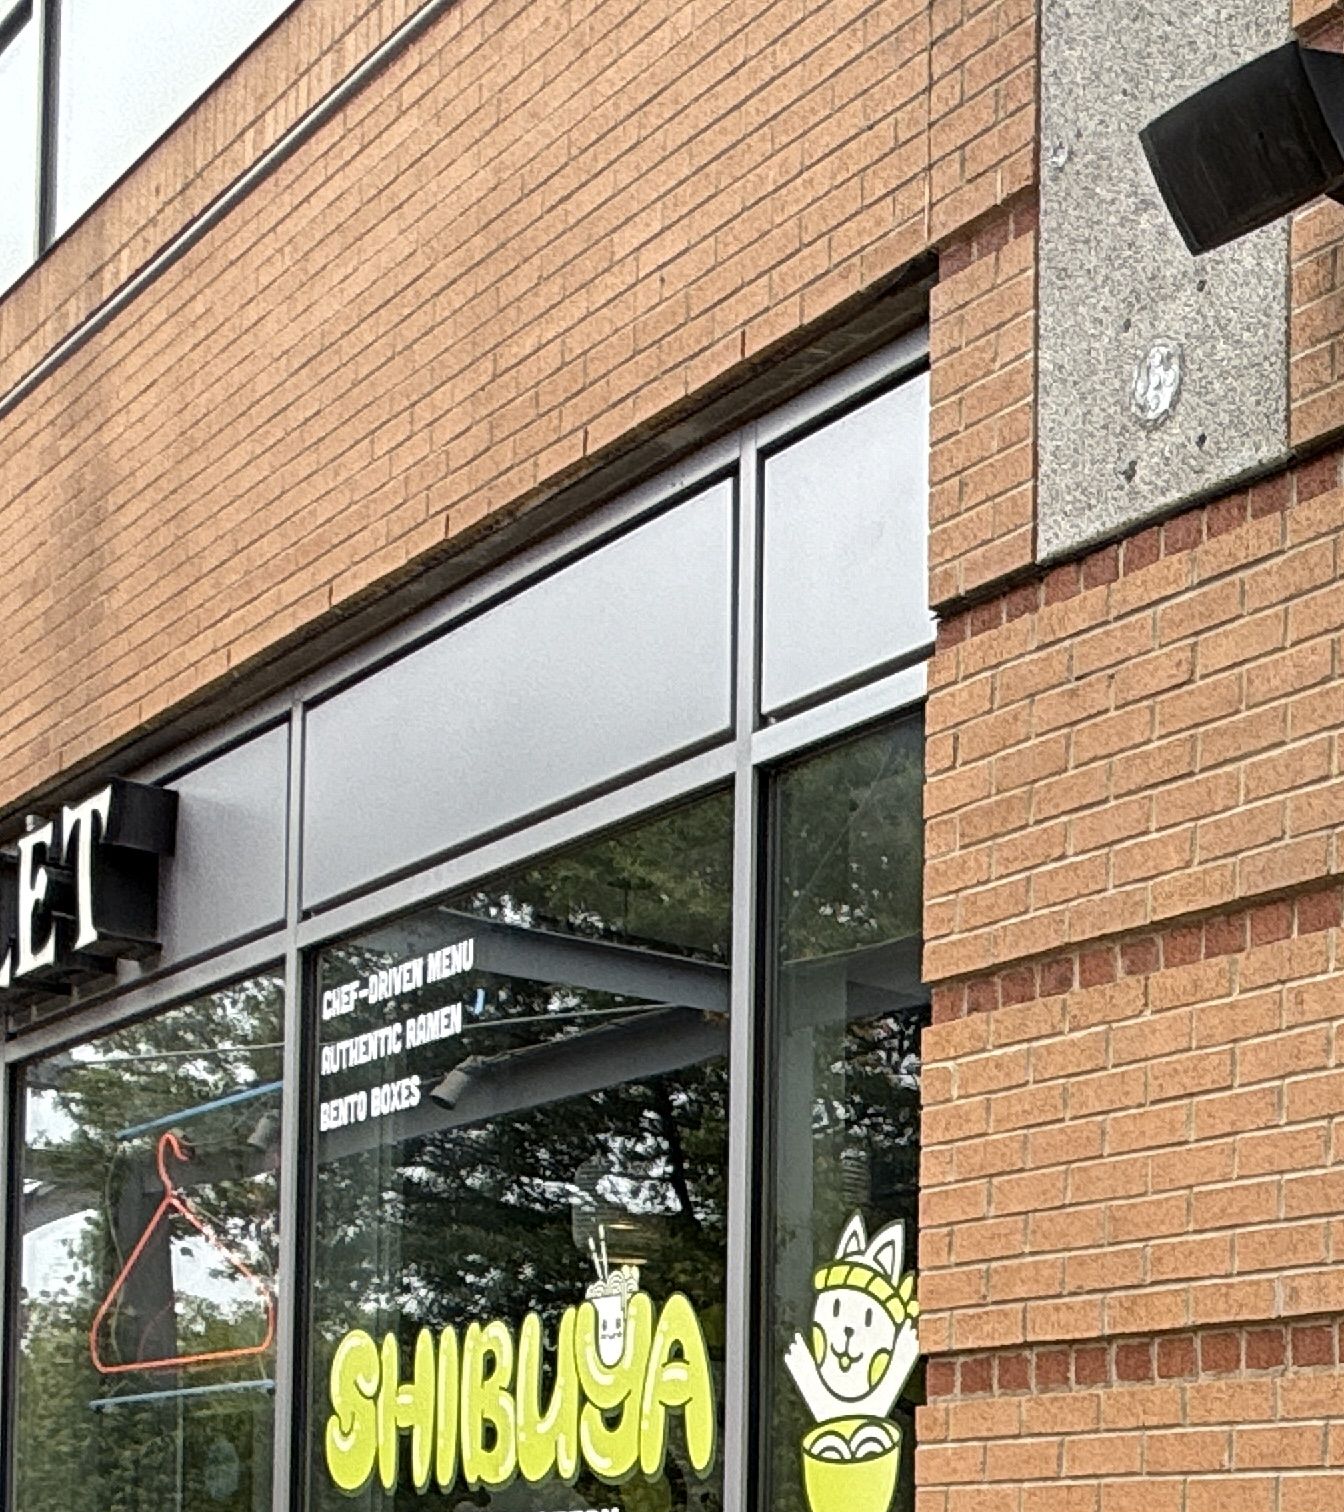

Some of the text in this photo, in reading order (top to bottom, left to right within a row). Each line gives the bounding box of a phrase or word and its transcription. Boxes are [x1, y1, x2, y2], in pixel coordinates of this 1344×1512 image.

[0, 783, 113, 988] ET
[321, 937, 475, 1021] CHEF-DRIVEN MENU
[320, 1000, 463, 1076] AUTHENTIC RAMEN
[319, 1074, 421, 1132] BENTO BOXES
[325, 1290, 717, 1497] SHIBUYA
